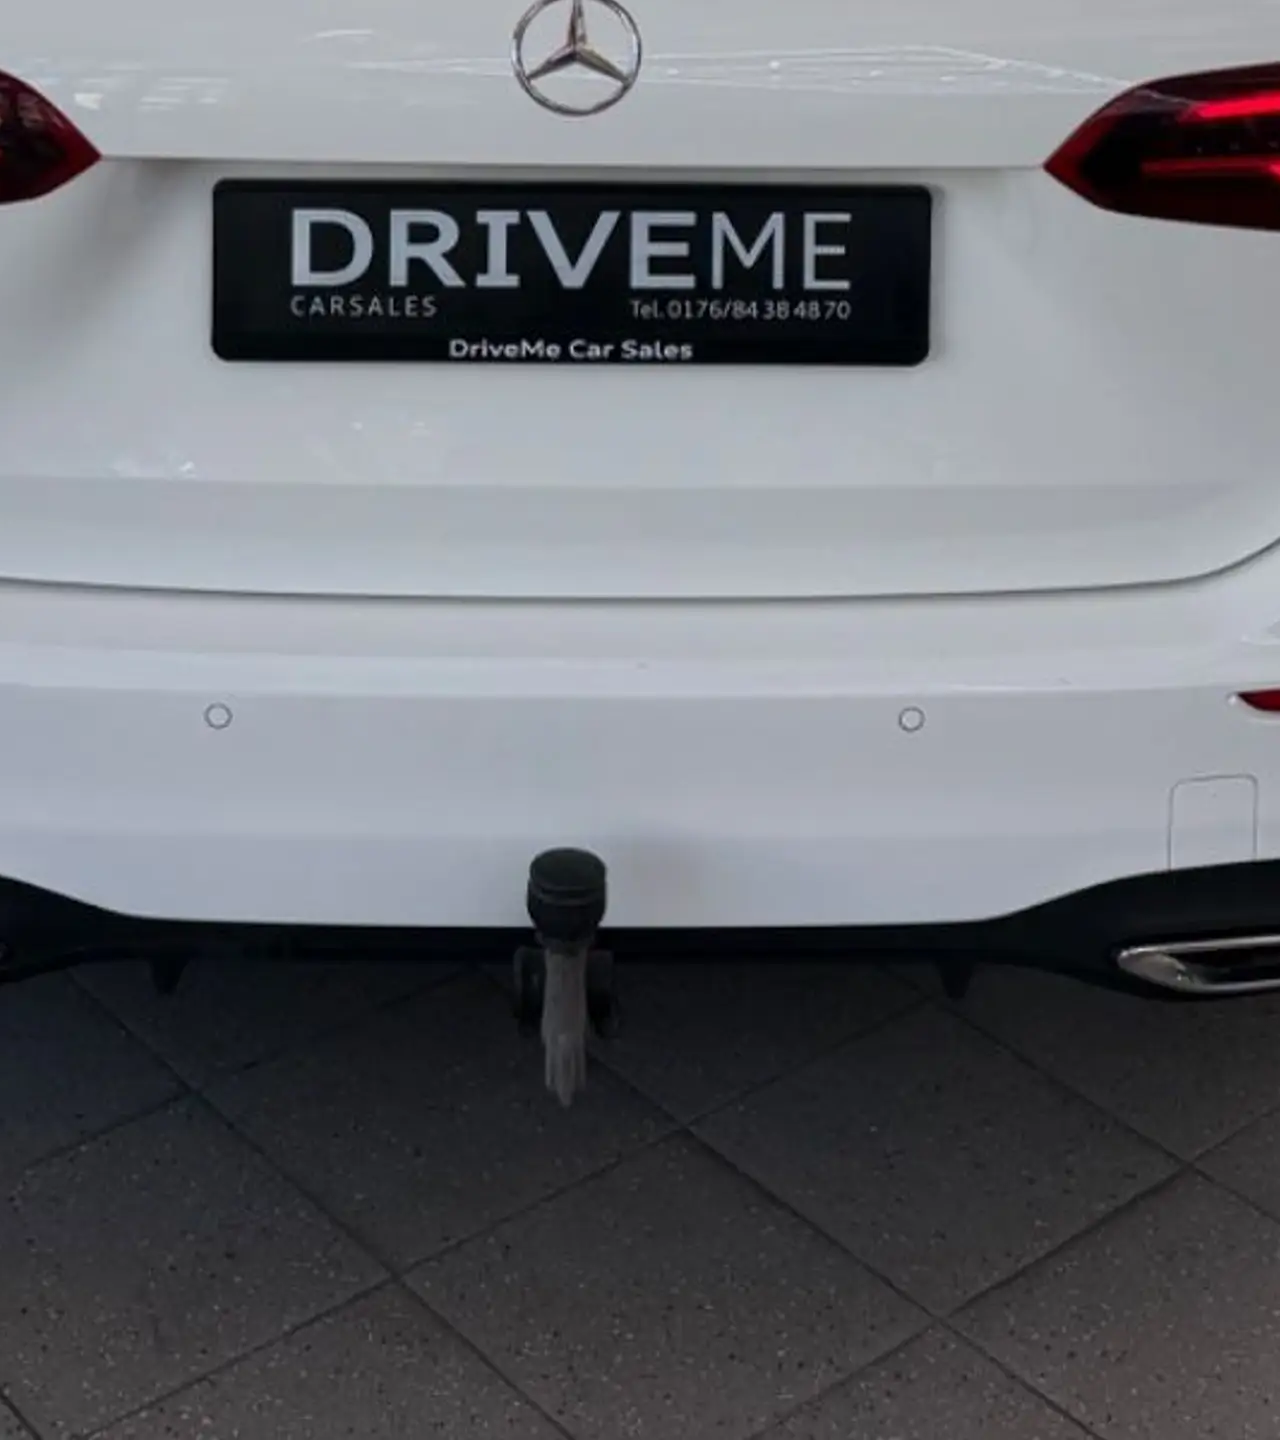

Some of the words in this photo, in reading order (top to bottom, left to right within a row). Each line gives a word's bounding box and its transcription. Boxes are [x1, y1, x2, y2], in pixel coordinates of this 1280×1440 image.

[291, 208, 852, 290] DRIVEME
[290, 295, 438, 317] CARSALES
[449, 338, 561, 358] DriveMe
[569, 339, 615, 358] Car
[620, 339, 693, 359] Sales
